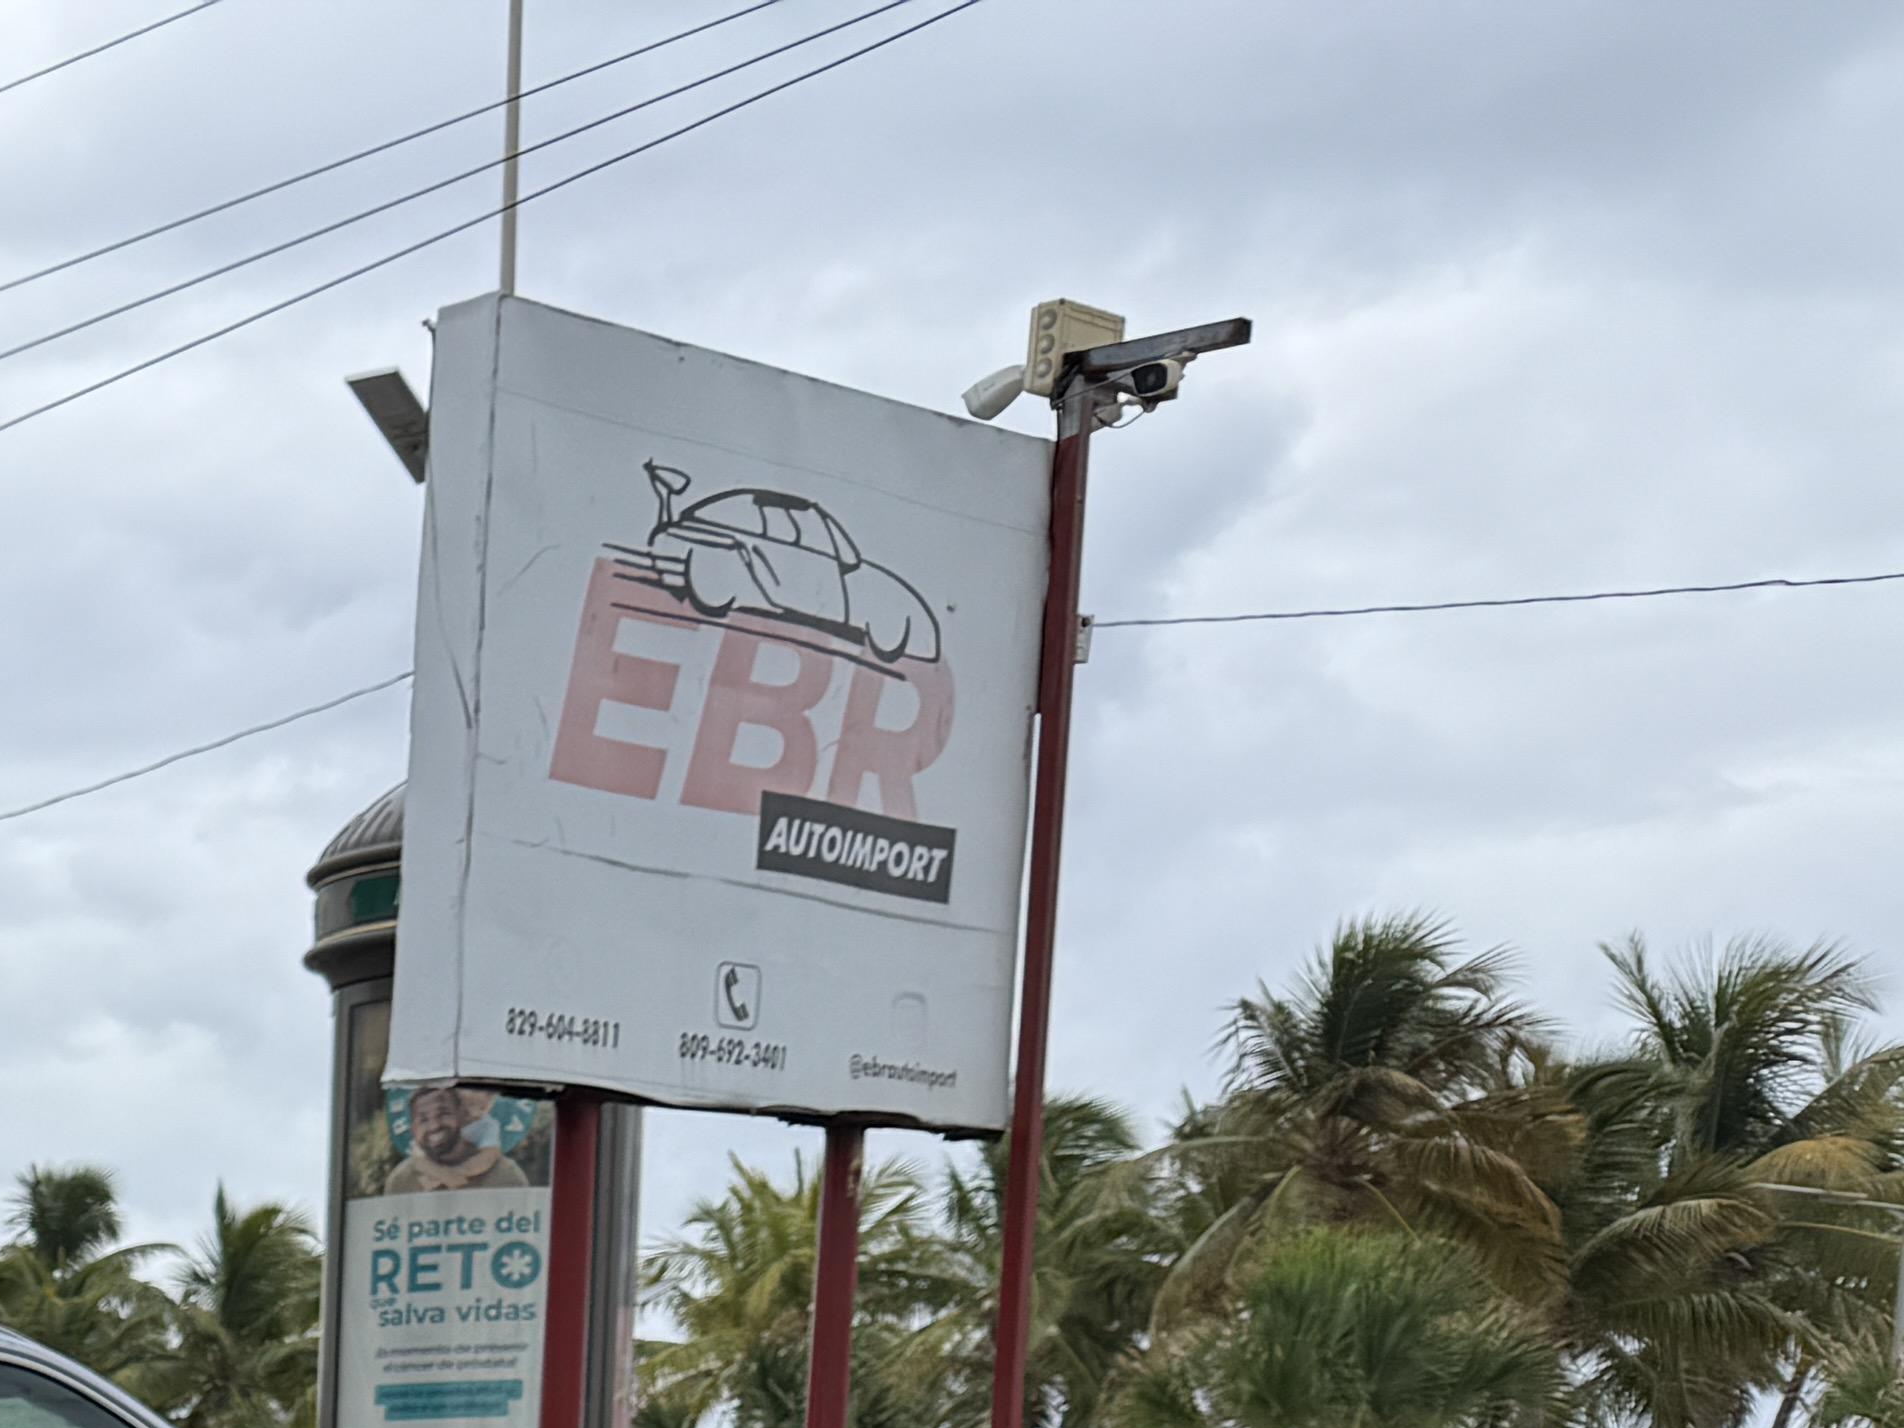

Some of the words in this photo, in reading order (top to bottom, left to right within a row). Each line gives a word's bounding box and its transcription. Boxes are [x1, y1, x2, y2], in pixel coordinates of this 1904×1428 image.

[549, 557, 954, 821] EBR
[765, 816, 949, 884] AUTOIMPORT
[505, 1006, 620, 1049] 829-604-8811
[679, 1032, 787, 1071] 809-692-3401
[373, 1216, 400, 1242] Sé
[407, 1217, 486, 1243] parte
[495, 1210, 541, 1234] del
[369, 1241, 542, 1297] RETO
[378, 1303, 446, 1327] salva
[456, 1298, 537, 1323] vidas
